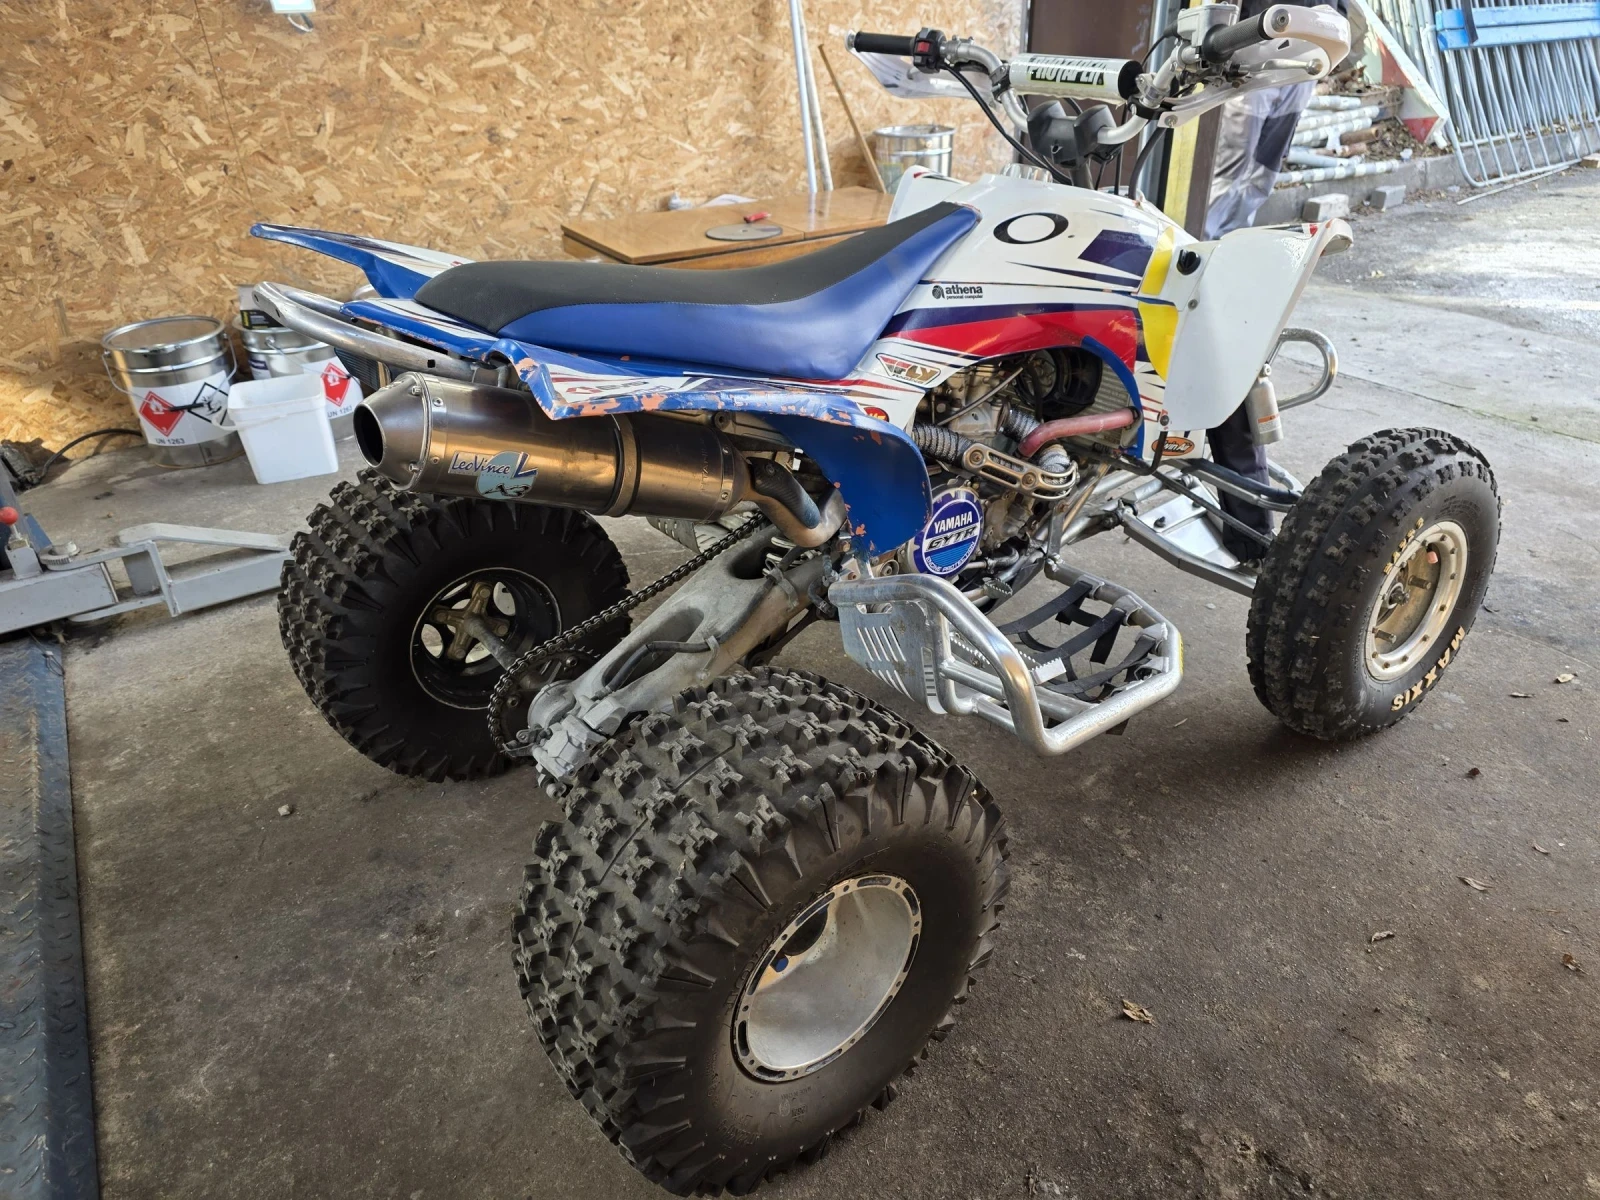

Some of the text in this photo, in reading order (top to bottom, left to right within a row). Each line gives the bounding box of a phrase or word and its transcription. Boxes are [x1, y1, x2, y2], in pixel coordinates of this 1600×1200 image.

[945, 285, 983, 294] athena
[452, 454, 510, 475] LeoVince
[934, 511, 973, 534] YAMAHA
[927, 526, 977, 551] GYTR
[1391, 625, 1466, 712] MAXXIS
